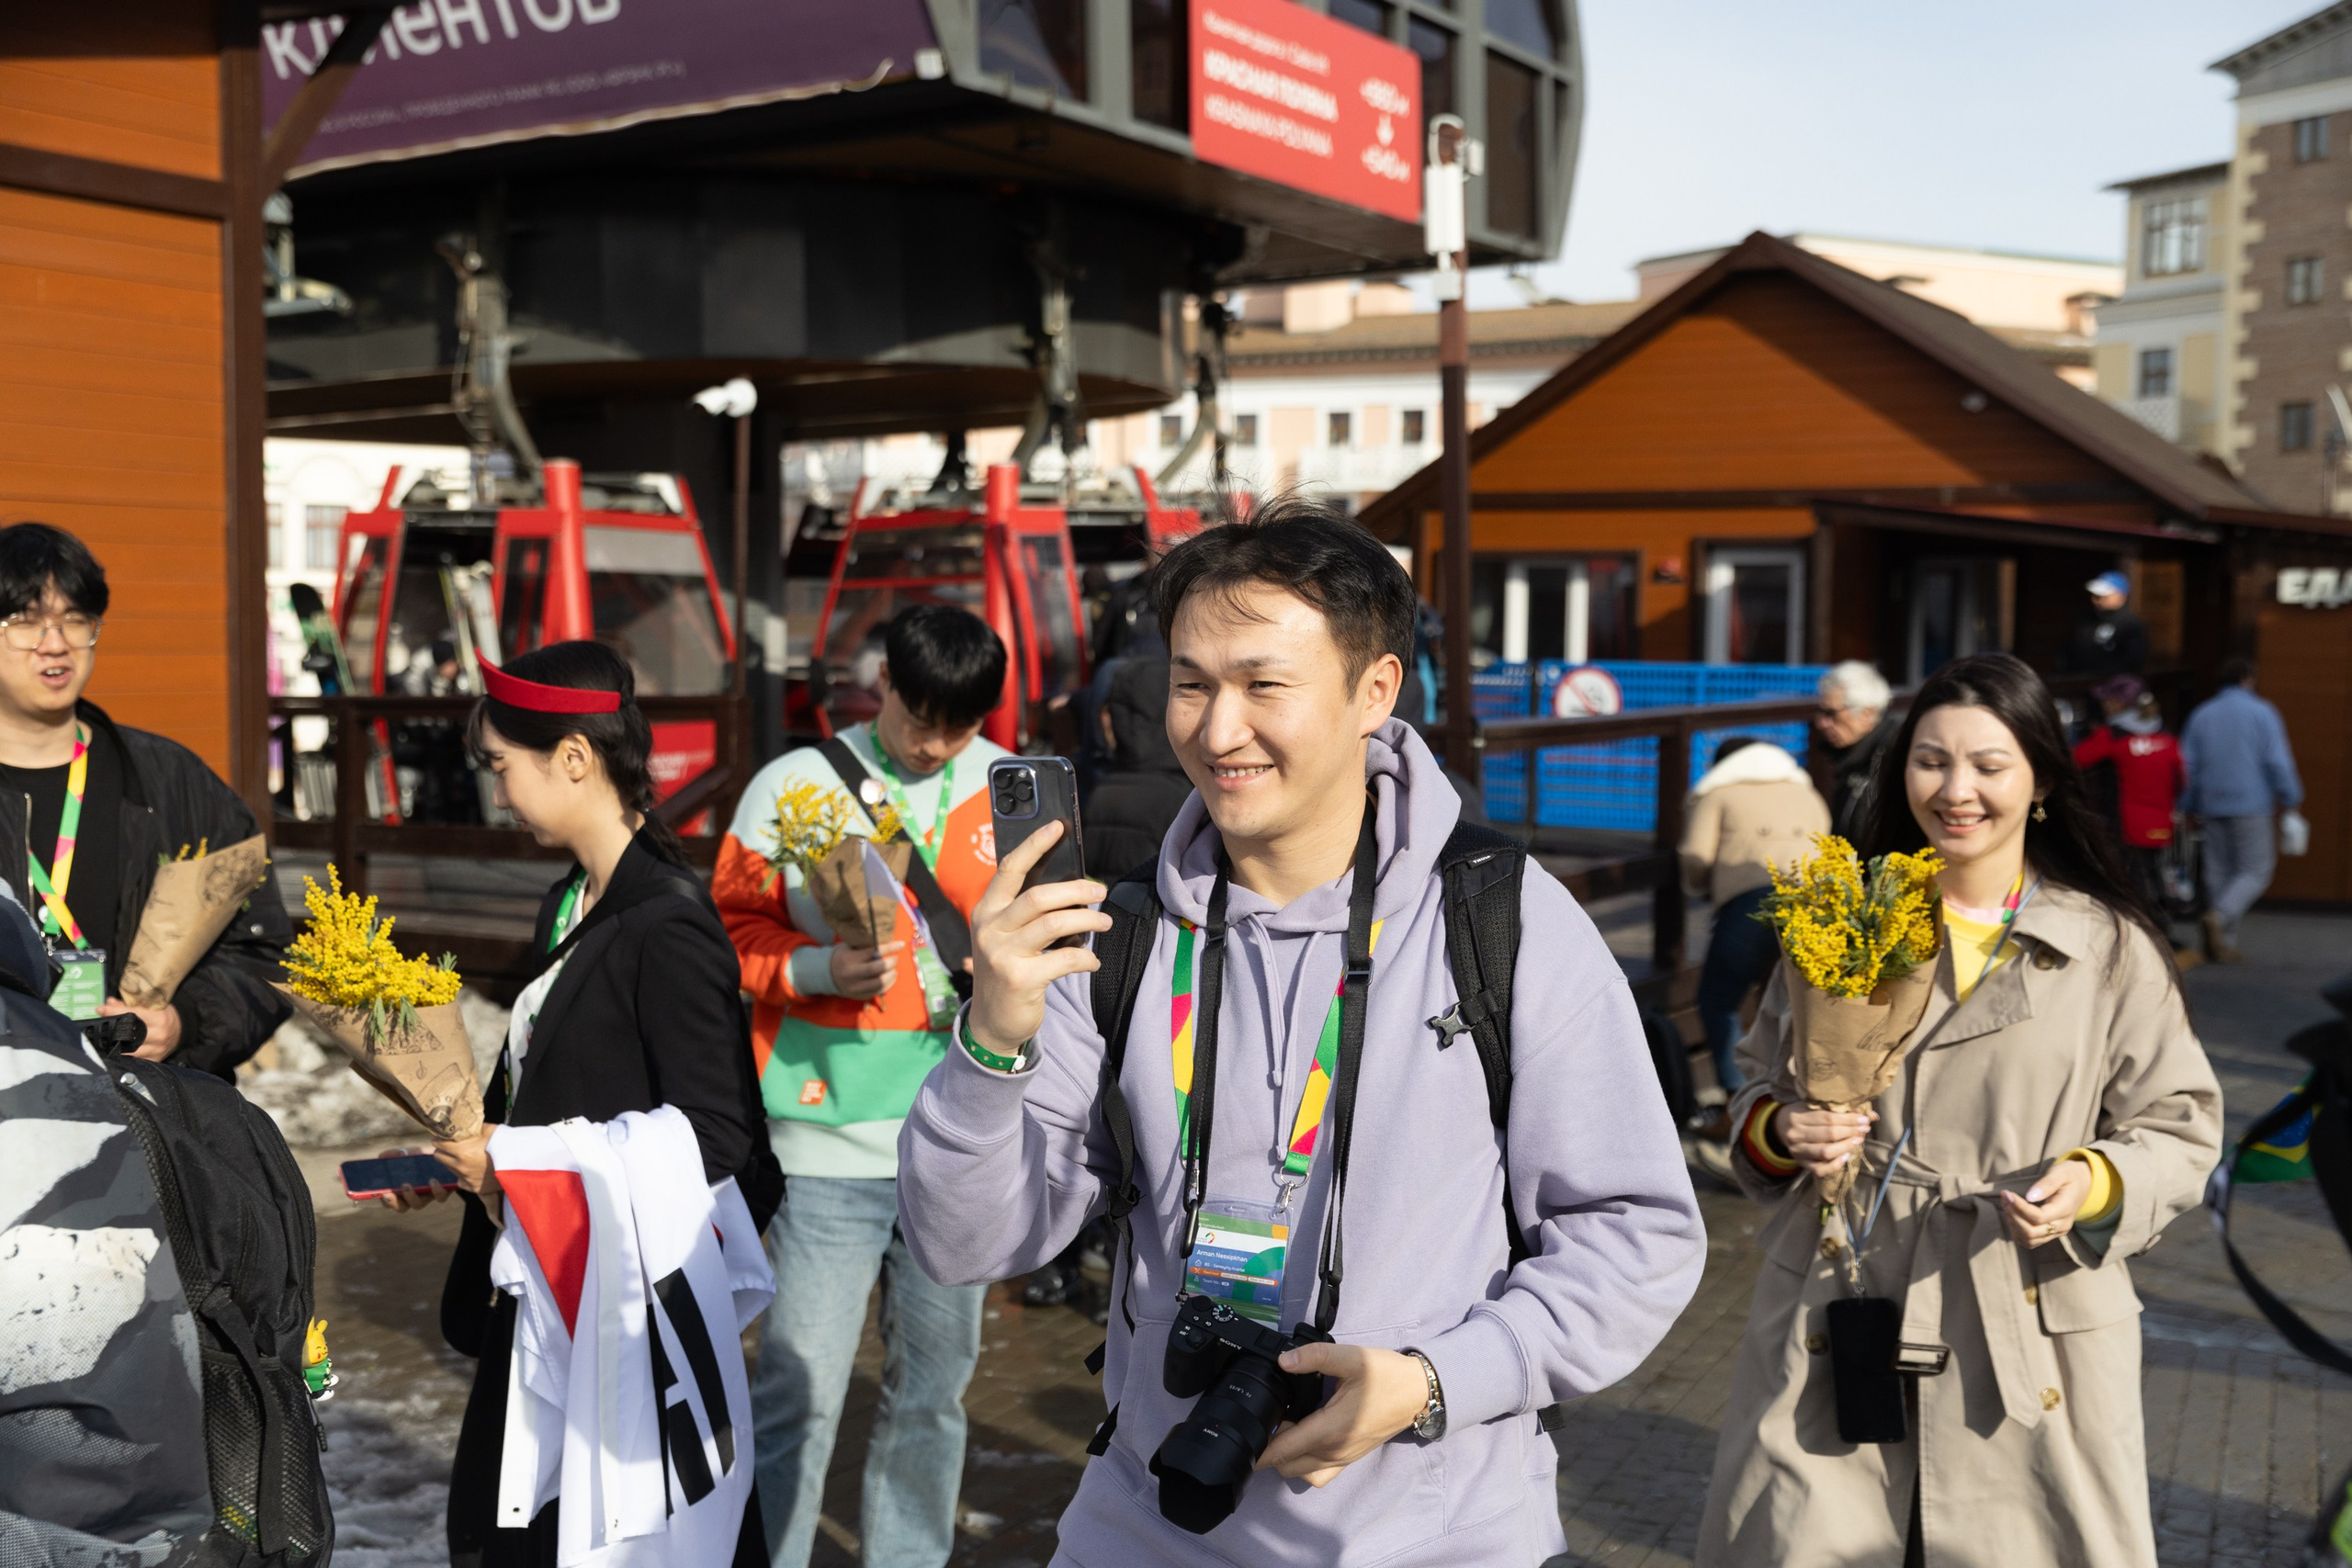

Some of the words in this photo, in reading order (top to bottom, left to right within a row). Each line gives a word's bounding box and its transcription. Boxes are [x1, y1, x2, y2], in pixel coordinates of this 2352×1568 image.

[2278, 567, 2352, 608] ЕД
[1219, 1337, 1241, 1349] SONY
[1203, 1427, 1218, 1438] SONY
